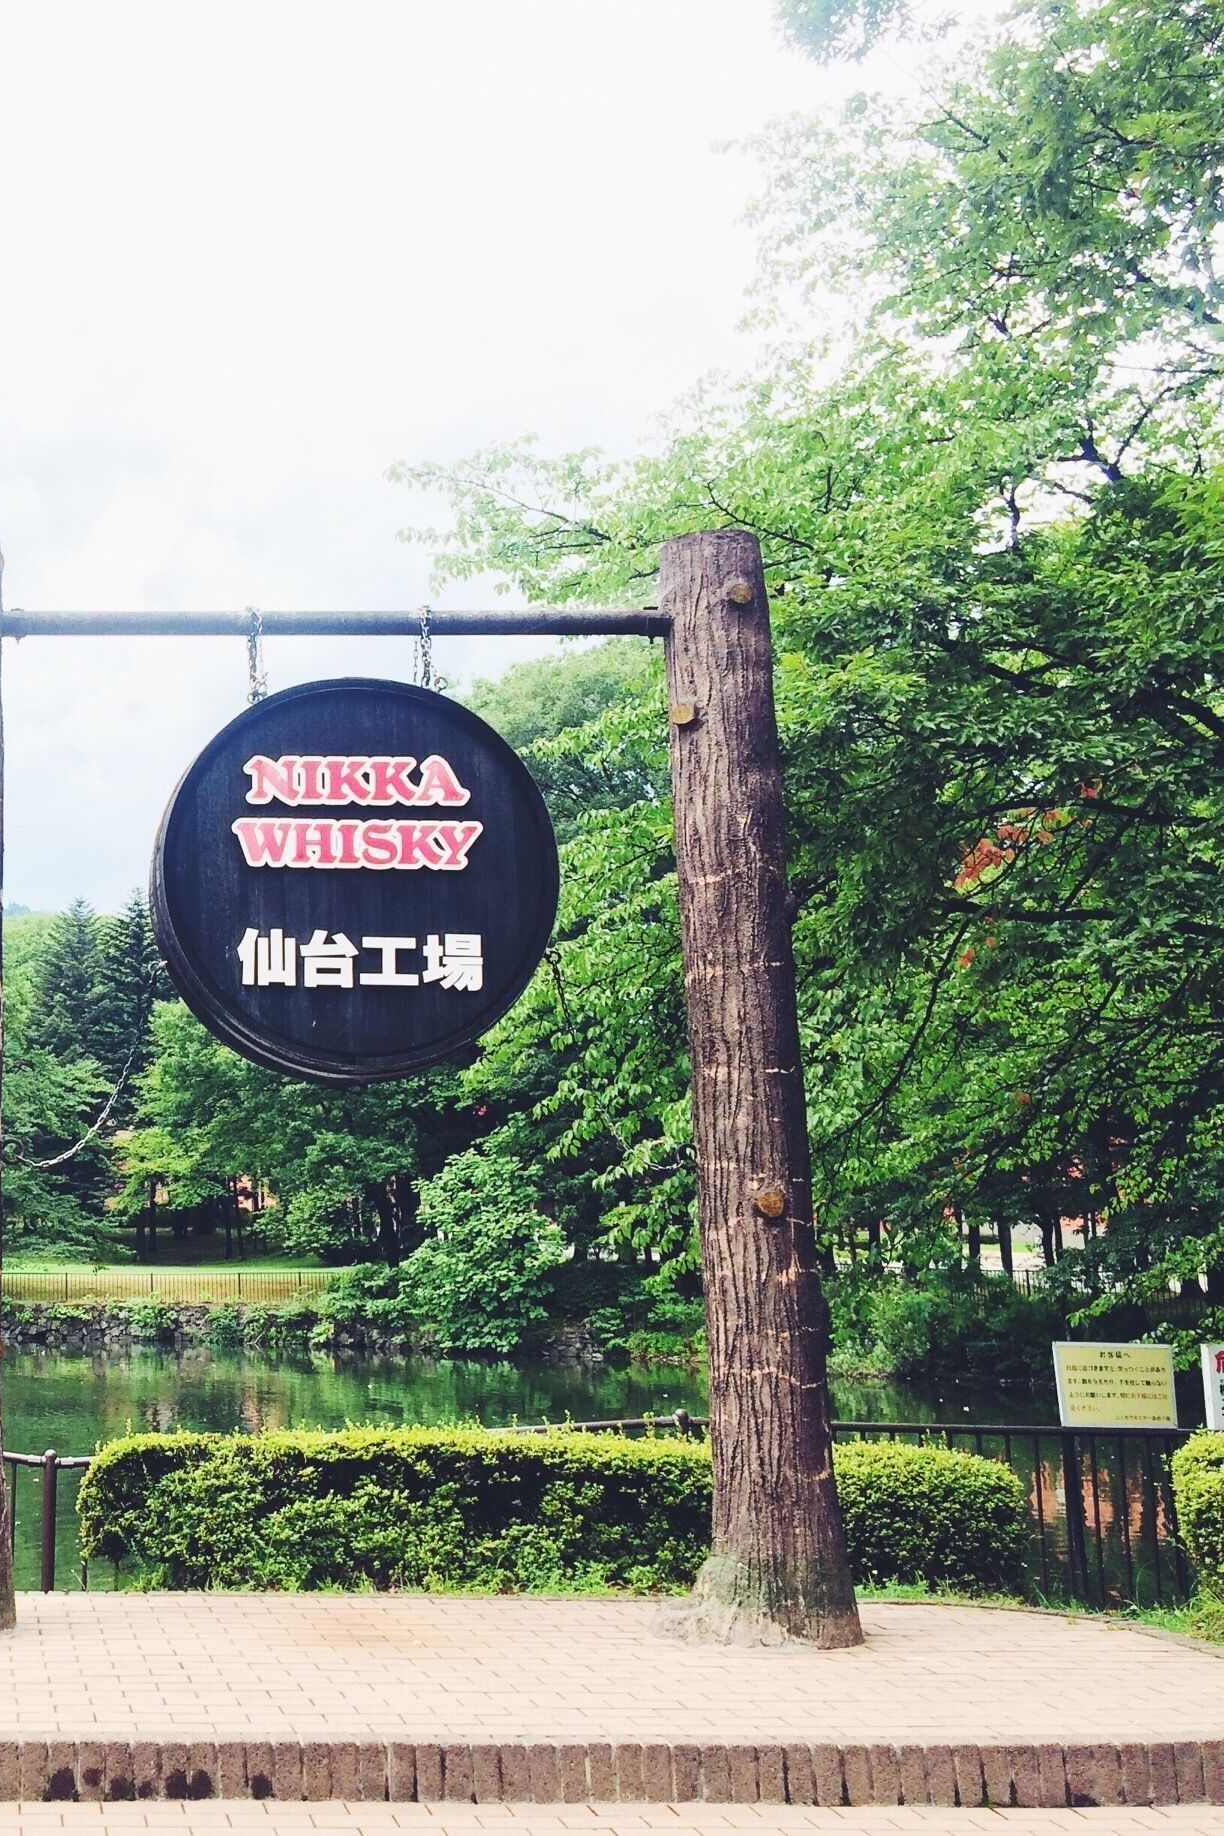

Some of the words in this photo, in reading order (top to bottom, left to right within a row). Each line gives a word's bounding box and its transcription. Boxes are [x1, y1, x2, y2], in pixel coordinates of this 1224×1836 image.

[244, 755, 471, 805] NIKKA
[232, 818, 483, 870] WHISKY
[237, 928, 483, 991] 仙台工場
